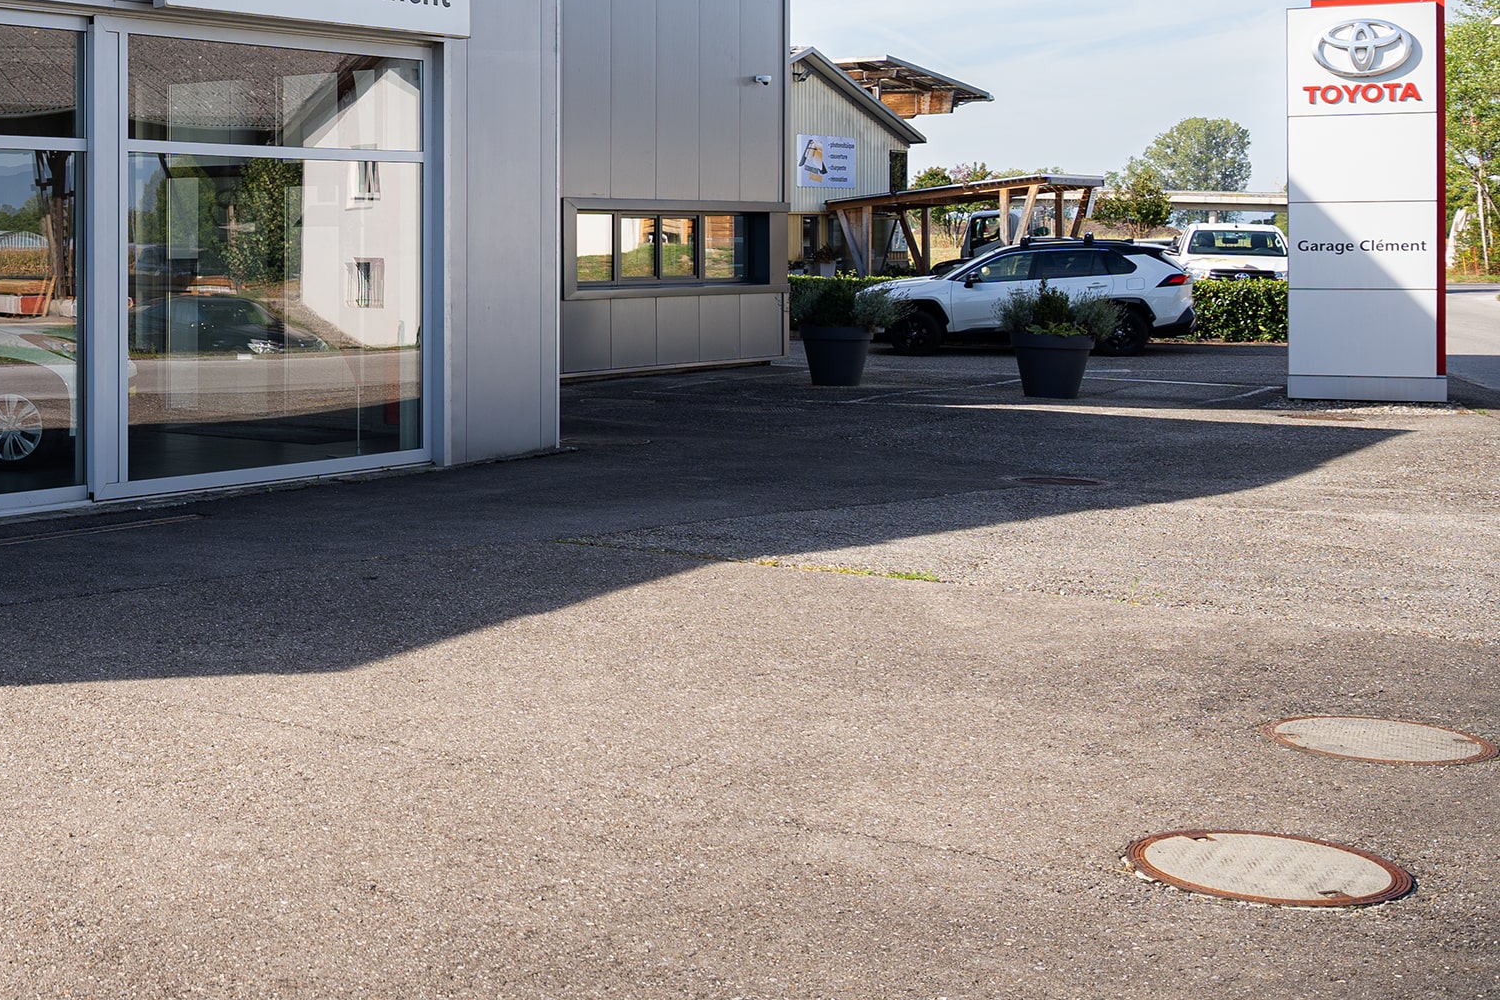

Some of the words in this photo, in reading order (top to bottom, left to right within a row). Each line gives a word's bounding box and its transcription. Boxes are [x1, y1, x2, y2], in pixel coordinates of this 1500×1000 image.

[1303, 82, 1422, 104] TOYOTA
[1297, 240, 1354, 255] Garage
[1359, 239, 1427, 252] Clément
